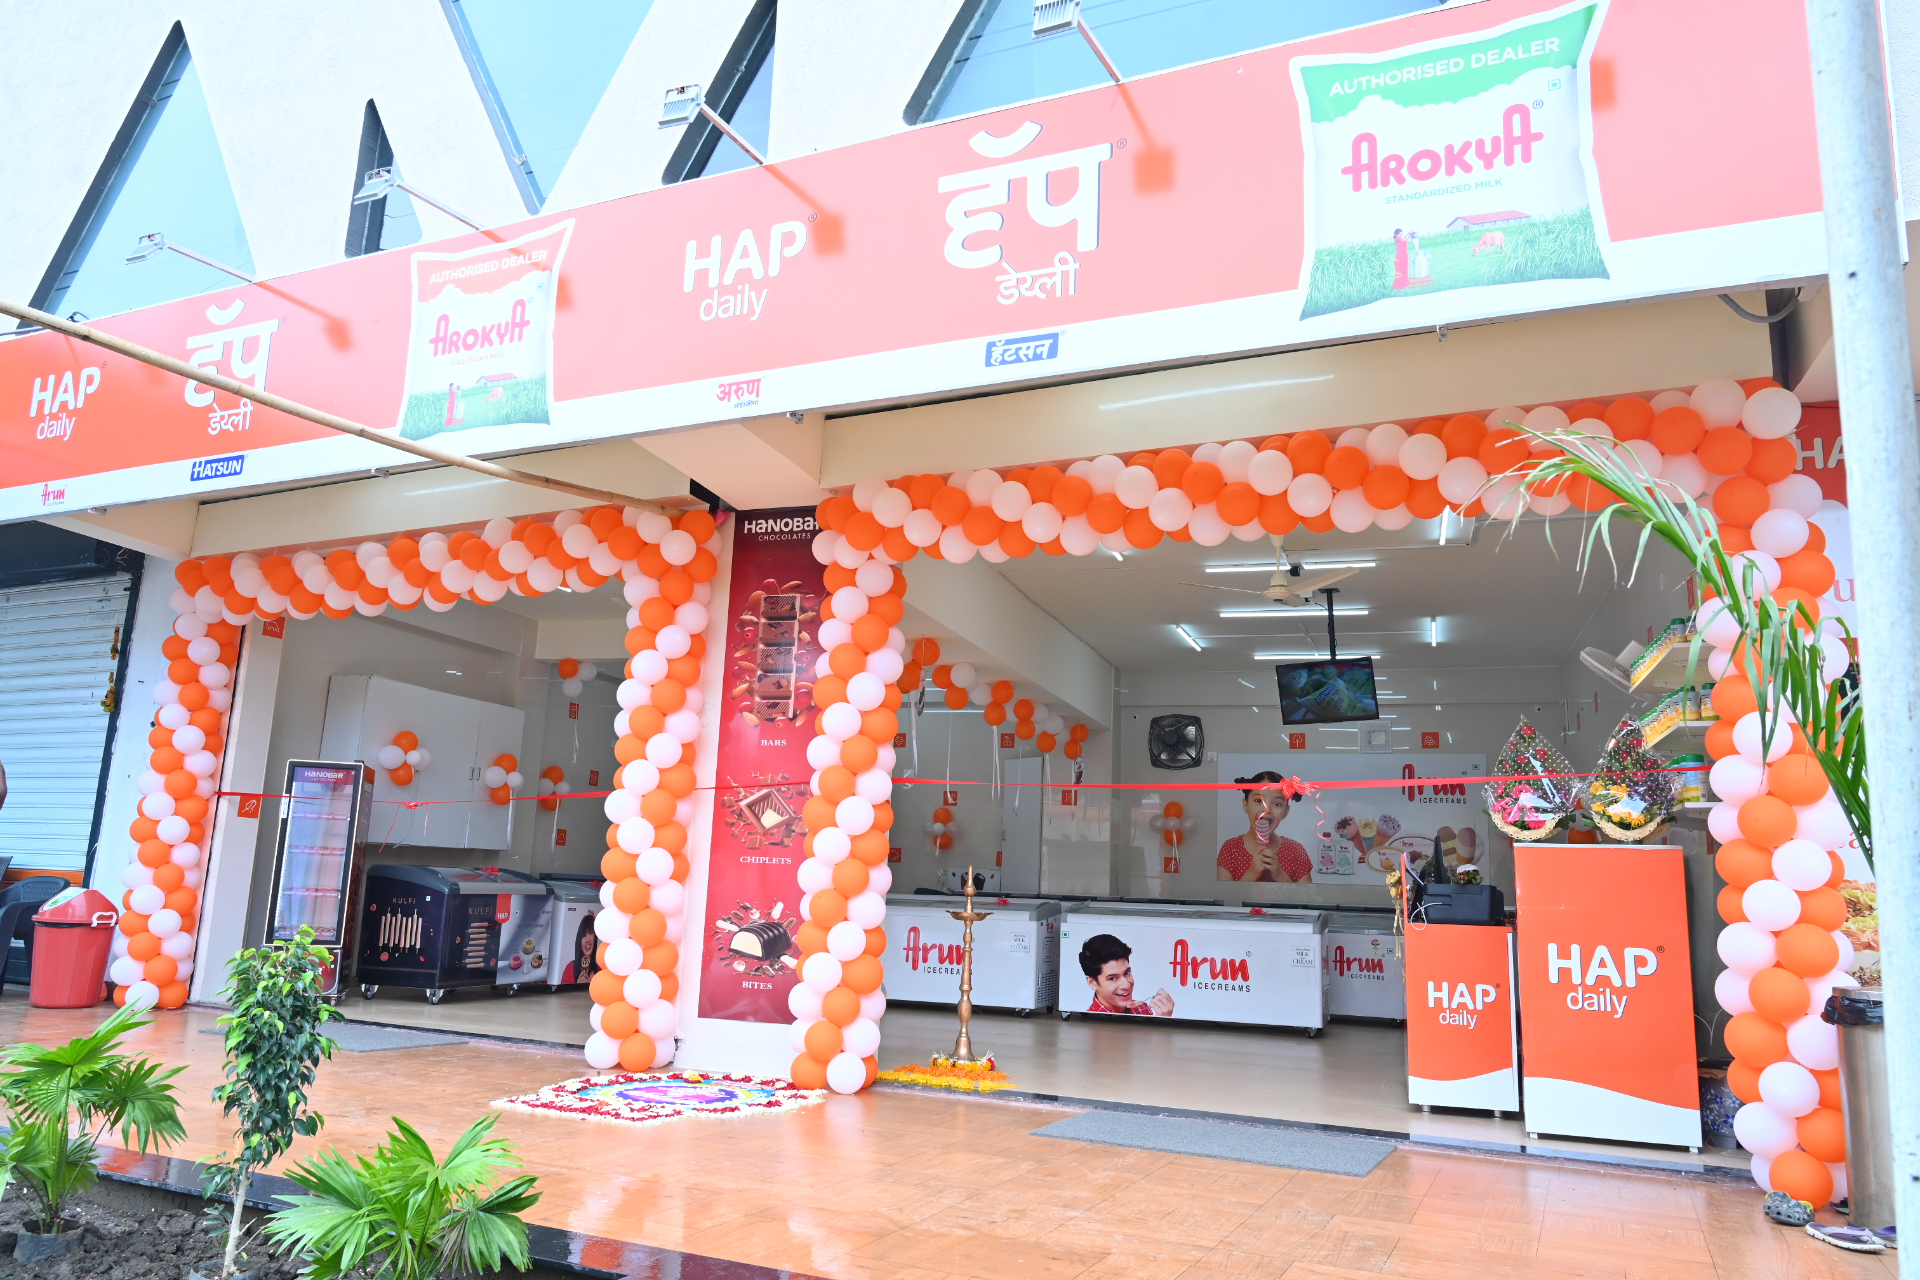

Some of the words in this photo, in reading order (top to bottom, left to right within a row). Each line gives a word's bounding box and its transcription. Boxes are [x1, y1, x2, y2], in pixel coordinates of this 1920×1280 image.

[1329, 57, 1465, 97] AUTHORISED
[1470, 37, 1560, 69] DEALER
[1341, 103, 1544, 192] AROKYA
[1385, 183, 1472, 204] STANDARDIZED
[1475, 178, 1503, 191] MILK
[428, 260, 499, 284] AUTHORISED
[501, 250, 547, 269] DEALER
[683, 221, 807, 293] HAP
[700, 284, 768, 321] daily
[429, 299, 530, 357] AROKYA
[450, 359, 465, 367] FULL
[466, 355, 489, 364] CREAM
[490, 352, 504, 360] MILK
[29, 366, 101, 417] HAP
[716, 378, 762, 402] अरुण
[36, 412, 76, 441] daily
[1795, 436, 1845, 470] HA
[193, 459, 242, 479] HATSUN
[41, 483, 66, 506] Arun
[758, 533, 811, 542] CHOCOLATES
[761, 739, 787, 747] BARS
[1402, 763, 1466, 802] Arun
[739, 855, 792, 865] CHIPLETS
[468, 907, 493, 915] KULFI
[497, 912, 509, 920] HAP
[903, 926, 973, 971] Arun
[1169, 938, 1250, 987] Arun
[1332, 945, 1385, 977] Arun
[923, 966, 973, 975] ICECREA
[1347, 973, 1385, 981] ICECREAMS
[1547, 942, 1658, 988] HAP
[742, 981, 773, 990] BITES
[1193, 981, 1251, 993] ICECREAMS
[1427, 980, 1497, 1010] HAP
[1566, 986, 1628, 1018] daily
[1439, 1009, 1478, 1029] daily
